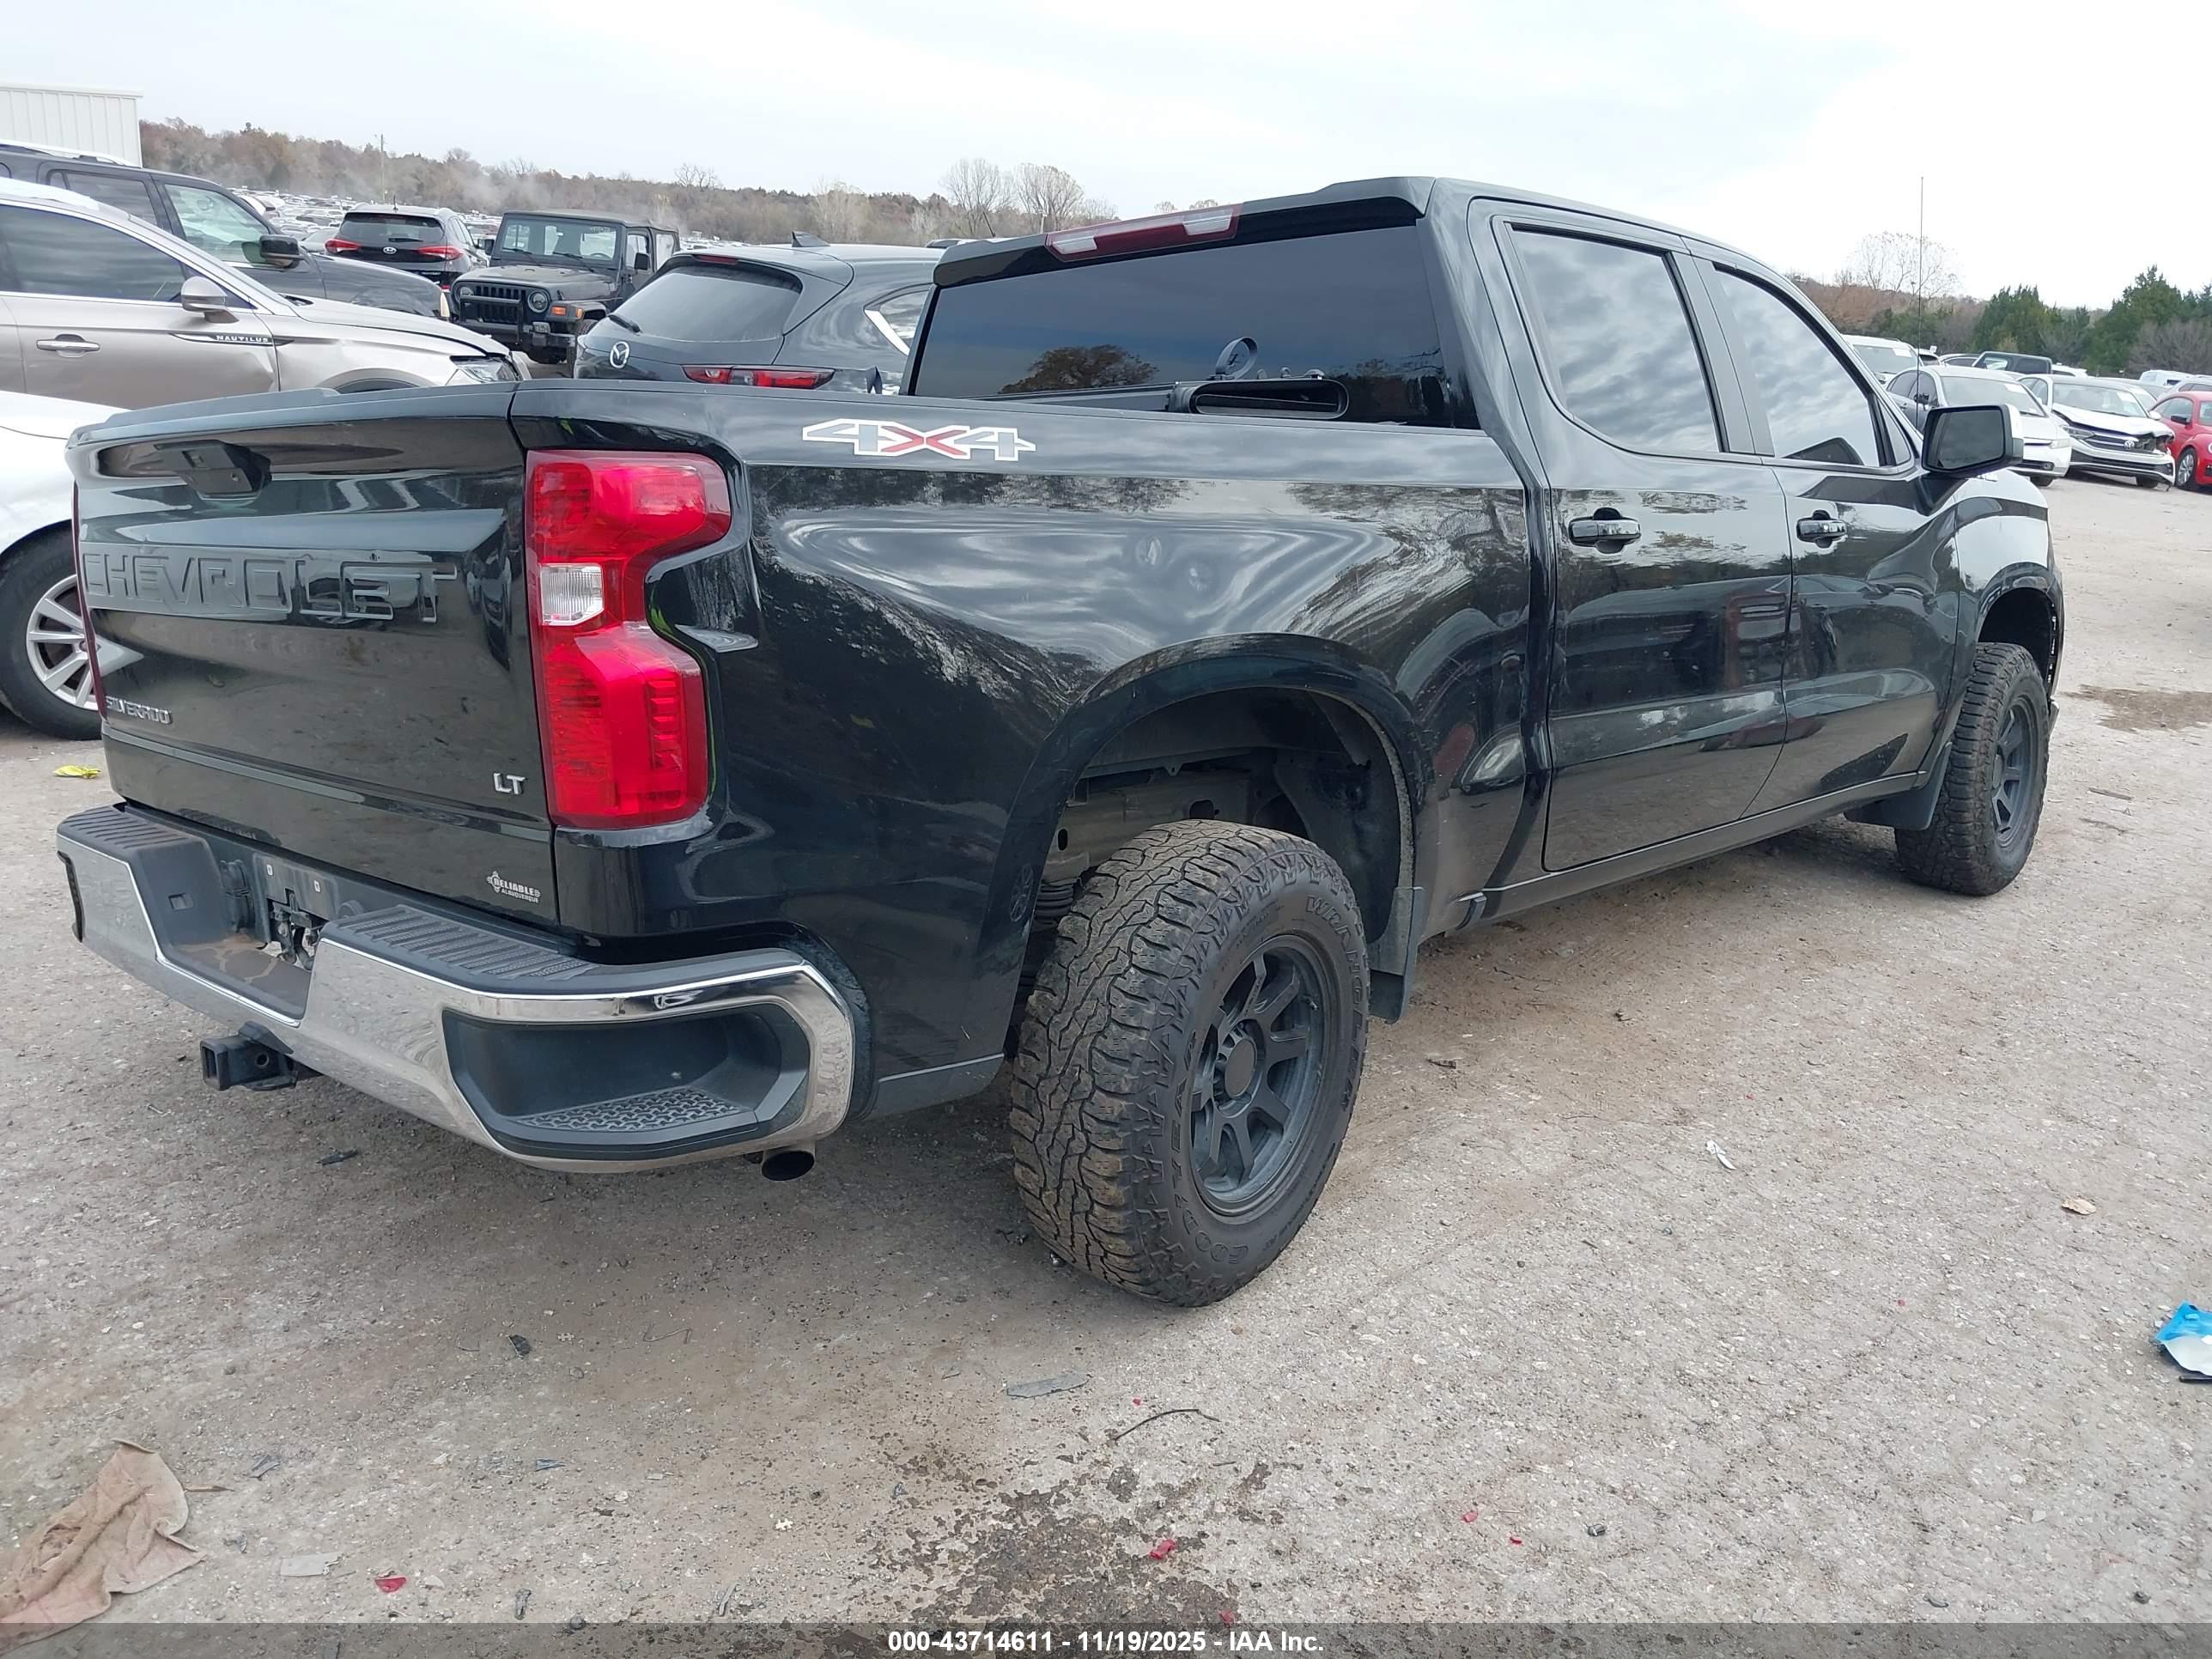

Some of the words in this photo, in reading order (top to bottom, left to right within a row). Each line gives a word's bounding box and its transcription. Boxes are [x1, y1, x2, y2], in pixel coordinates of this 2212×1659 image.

[82, 552, 458, 623] CHEVROLET
[493, 772, 526, 795] LT
[493, 877, 536, 896] RELIABLE
[1304, 895, 1364, 1112] WRANGLER
[1170, 1030, 1250, 1266] GOODYEAR
